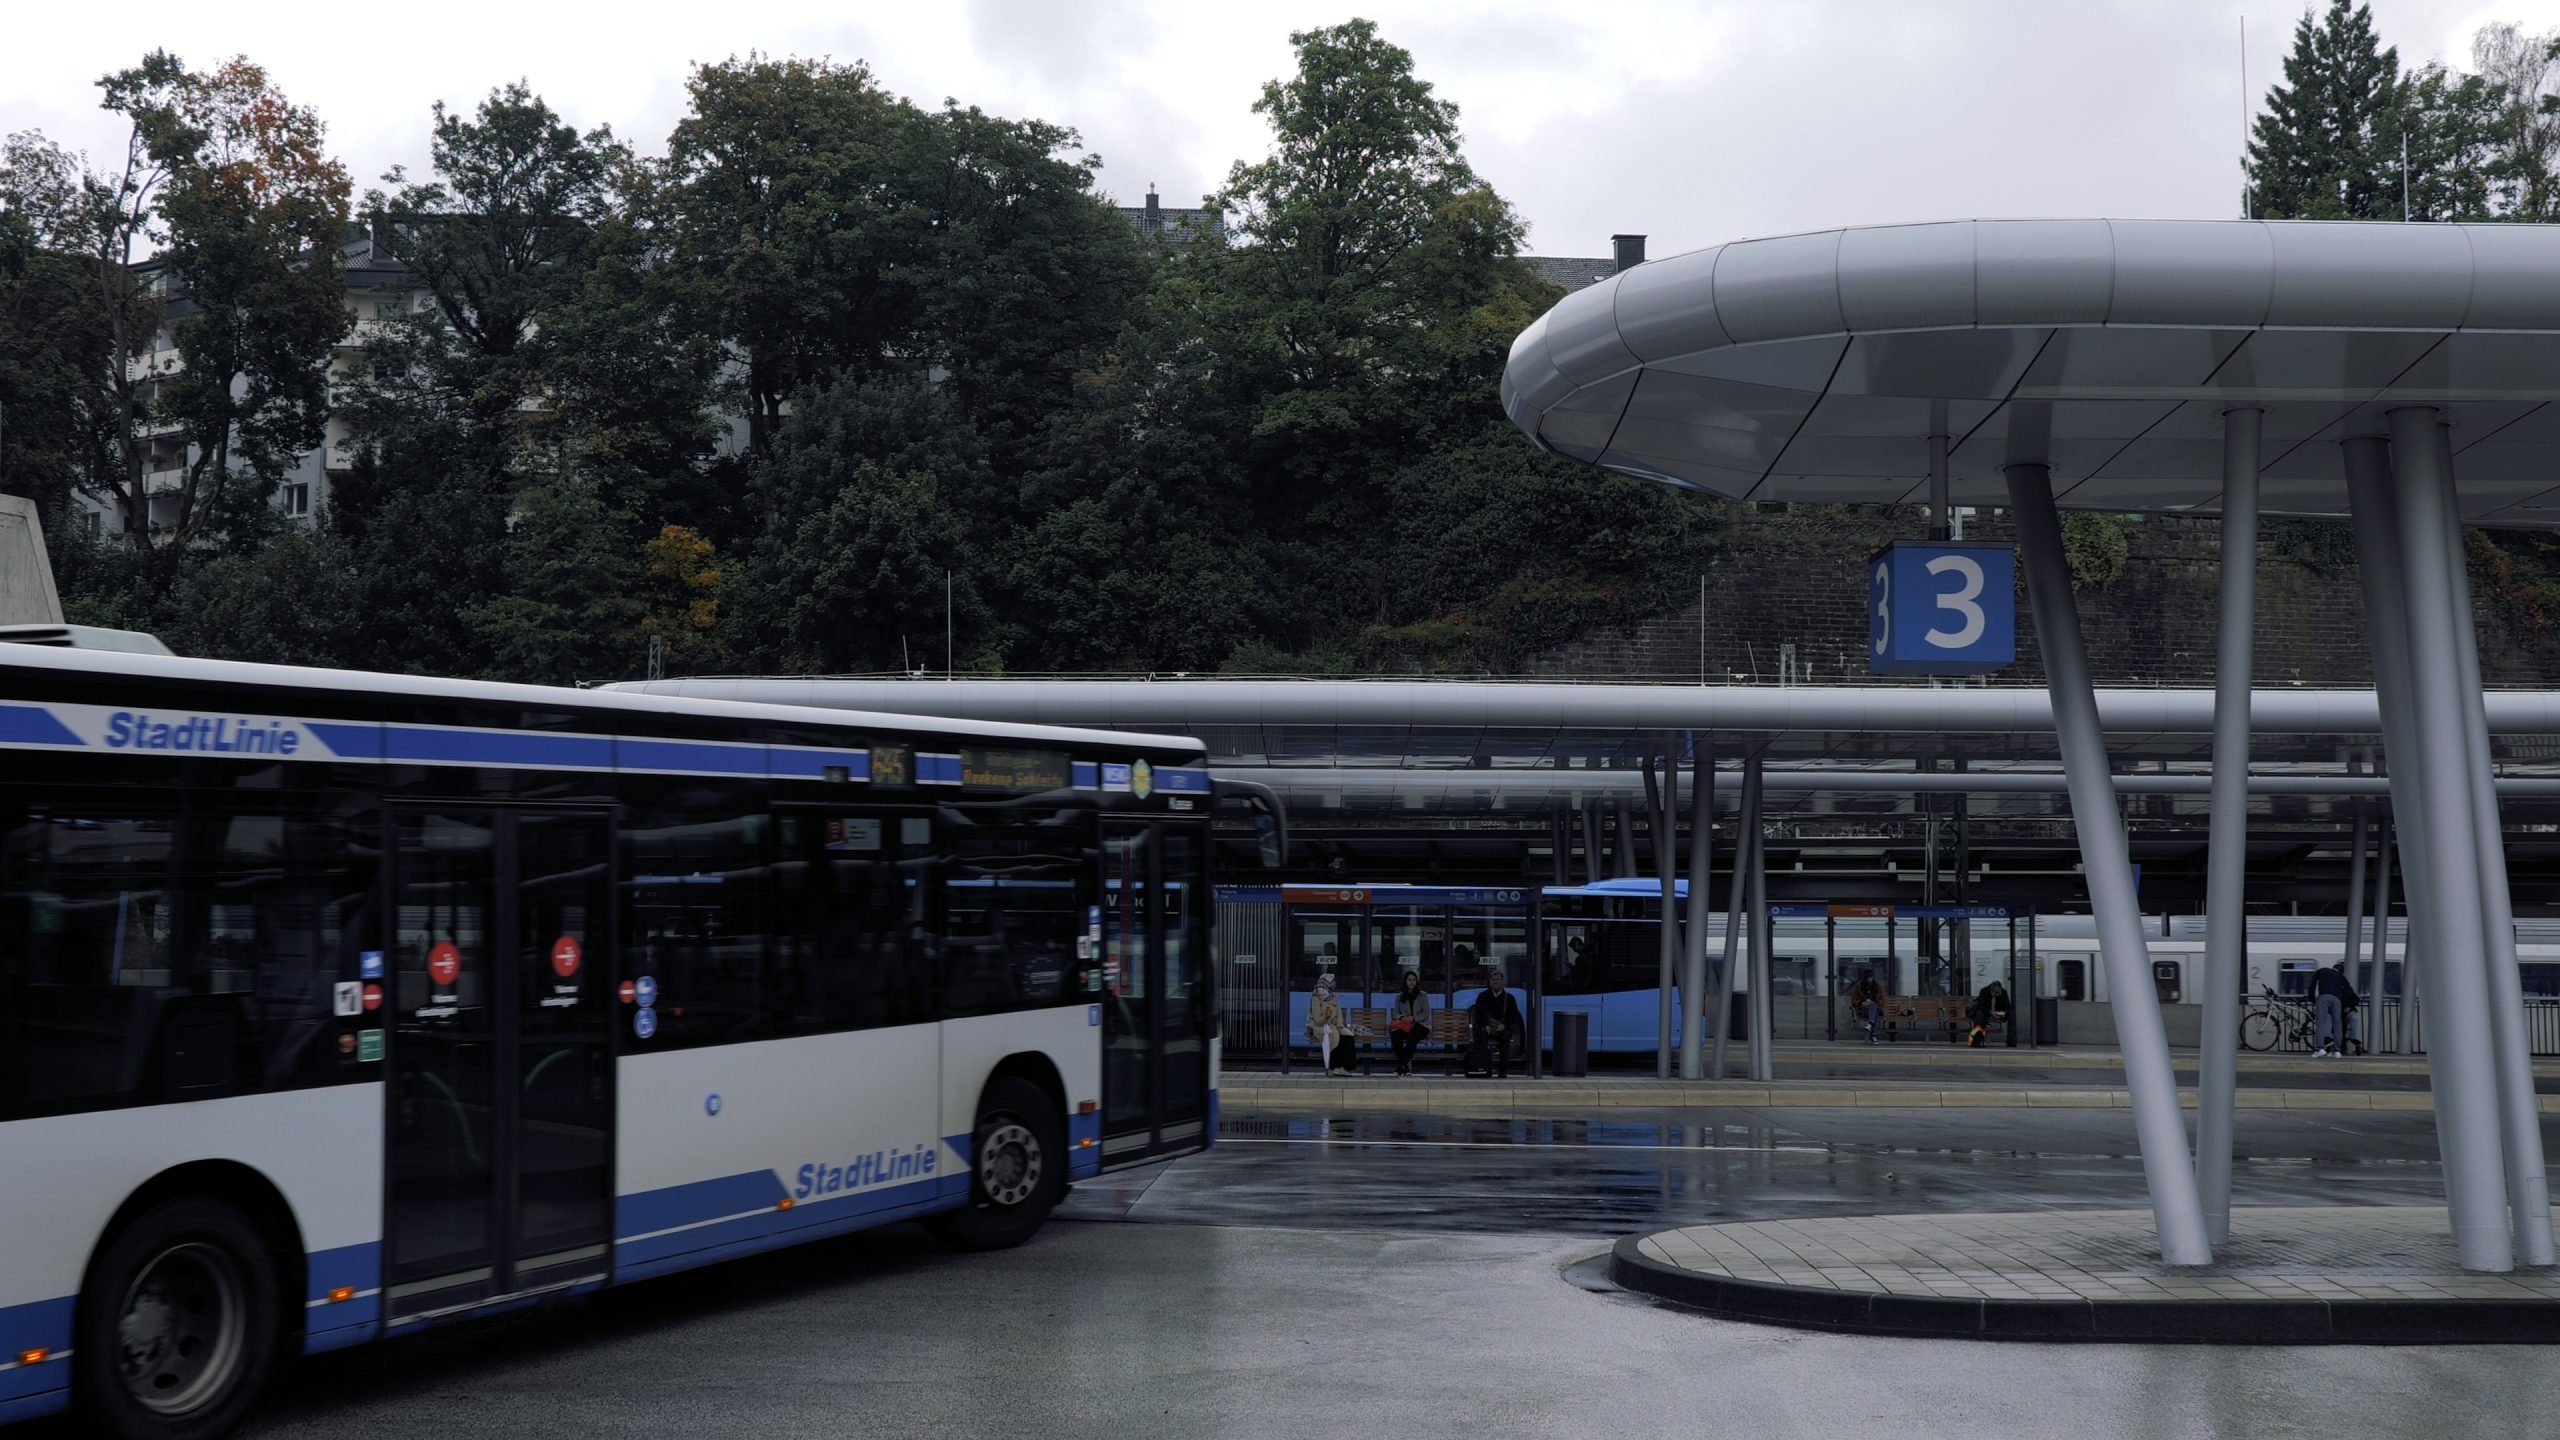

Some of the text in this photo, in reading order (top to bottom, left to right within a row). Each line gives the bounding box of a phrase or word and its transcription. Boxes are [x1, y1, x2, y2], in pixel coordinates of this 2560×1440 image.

[1876, 562, 1890, 655] 3
[1924, 555, 1985, 649] 3
[105, 711, 300, 755] StadtLinie
[2250, 966, 2260, 979] 2
[794, 1144, 937, 1199] StadtLinie
